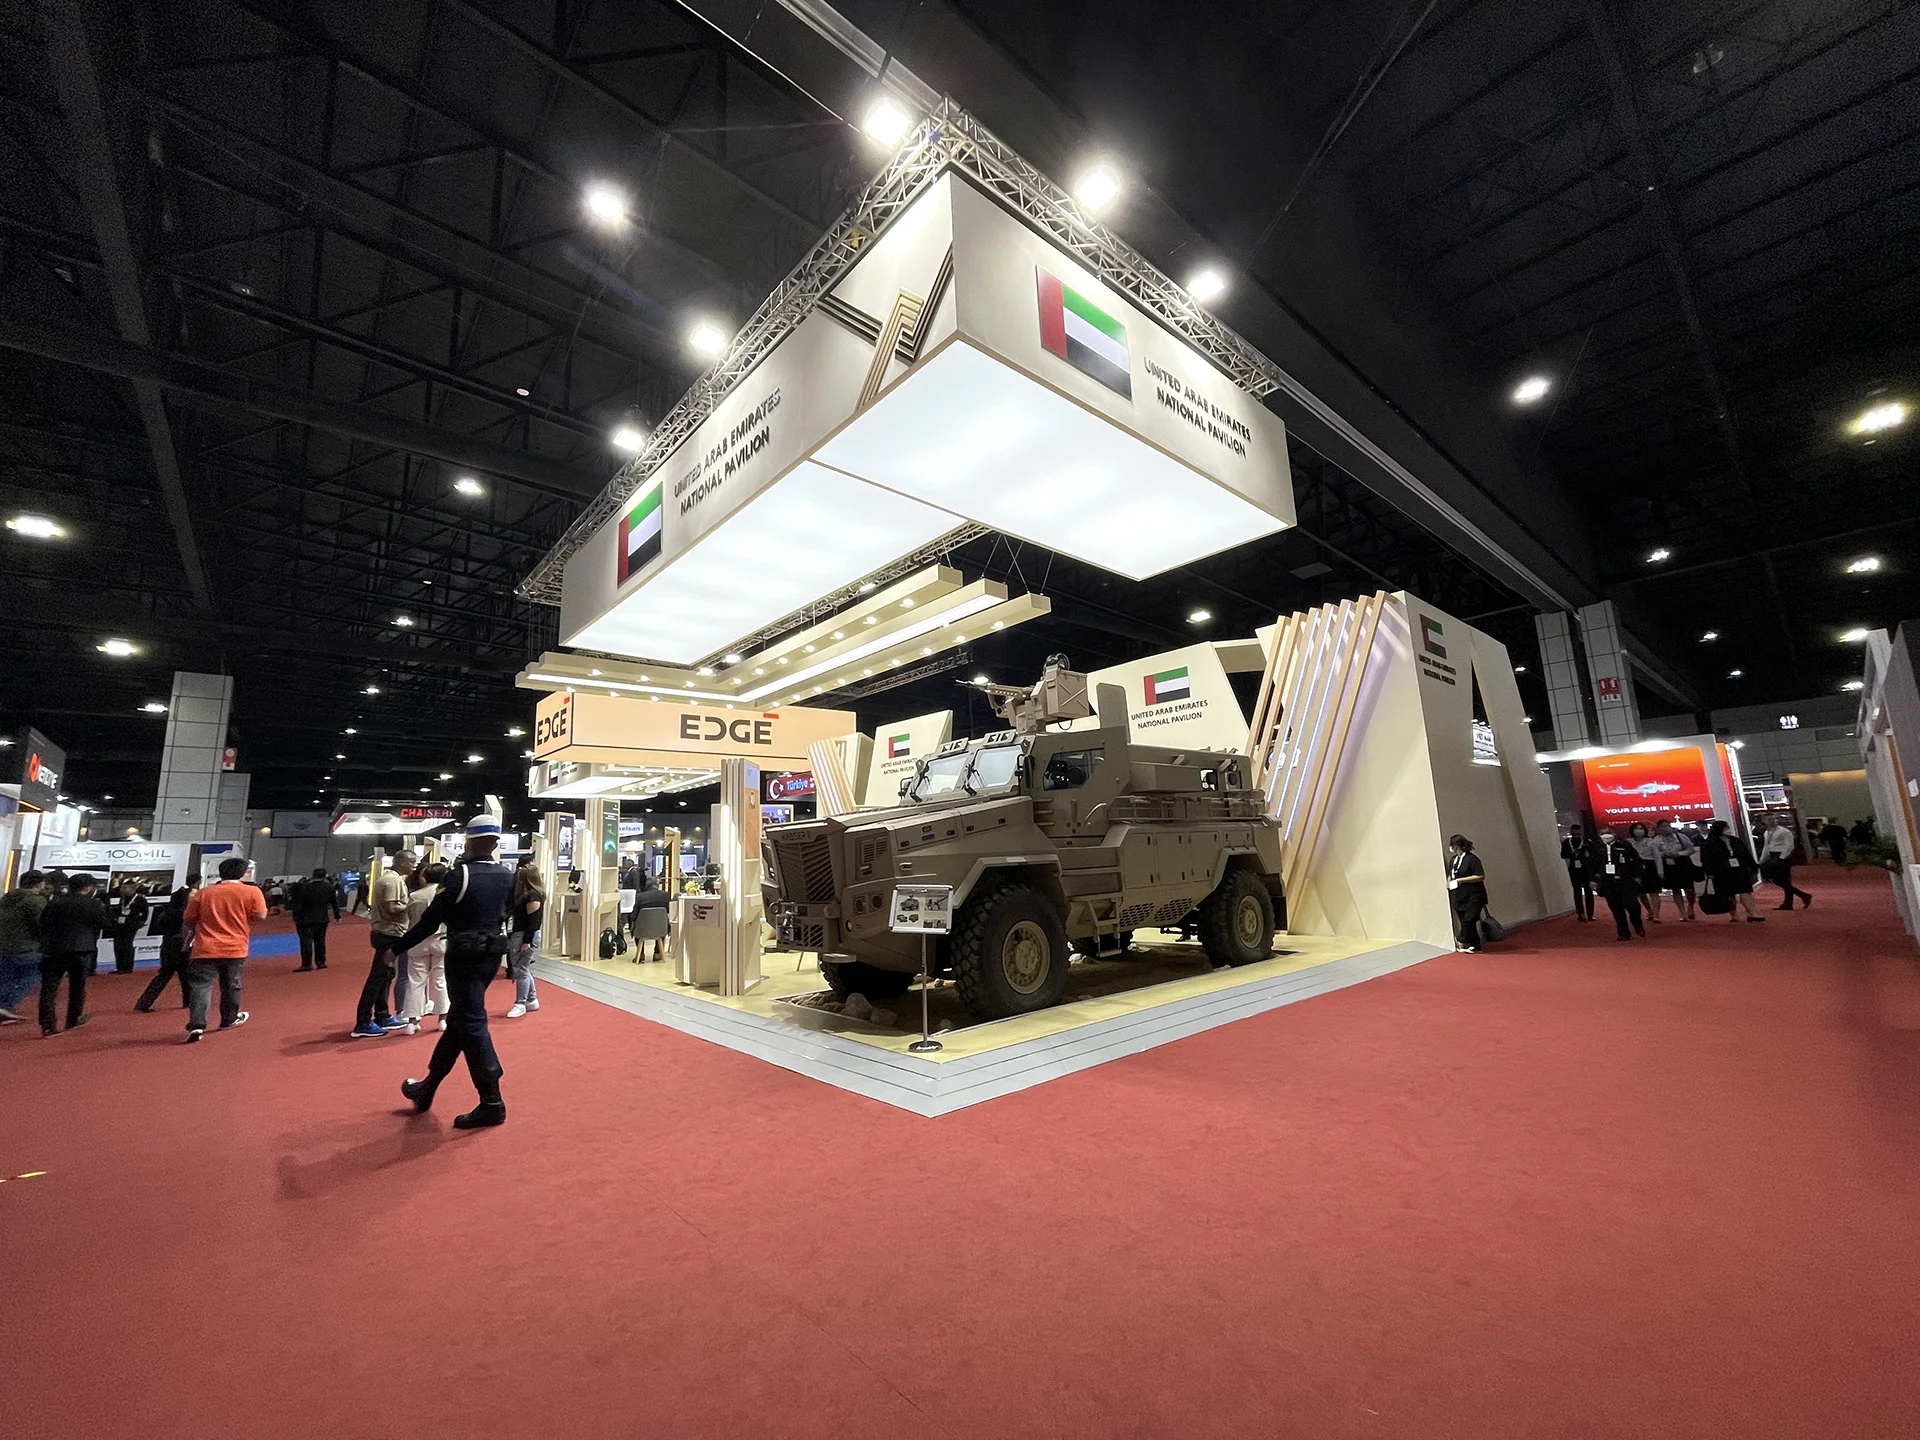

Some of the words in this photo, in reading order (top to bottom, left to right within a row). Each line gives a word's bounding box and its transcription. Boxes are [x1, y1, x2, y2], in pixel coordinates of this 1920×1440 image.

[1143, 356, 1181, 393] UNITED
[1184, 386, 1209, 414] ARAB
[1211, 404, 1252, 444] EMIRATES
[1156, 386, 1206, 433] NATIONAL
[1207, 421, 1247, 459] PAVILION
[674, 462, 702, 498] UNITED
[704, 437, 728, 473] ARAB
[730, 387, 781, 447] EMIRATES
[680, 468, 723, 517] NATIONAL
[724, 425, 771, 481] PAVILION
[536, 707, 568, 746] EDGE
[680, 713, 772, 745] EDGE
[1131, 710, 1154, 721] UNITED
[1155, 706, 1174, 716] ARAB
[1174, 700, 1208, 713] EMIRATES
[1137, 718, 1170, 729] NATIONAL
[1171, 712, 1202, 724] PAVILION
[400, 808, 452, 818] CHAISERI
